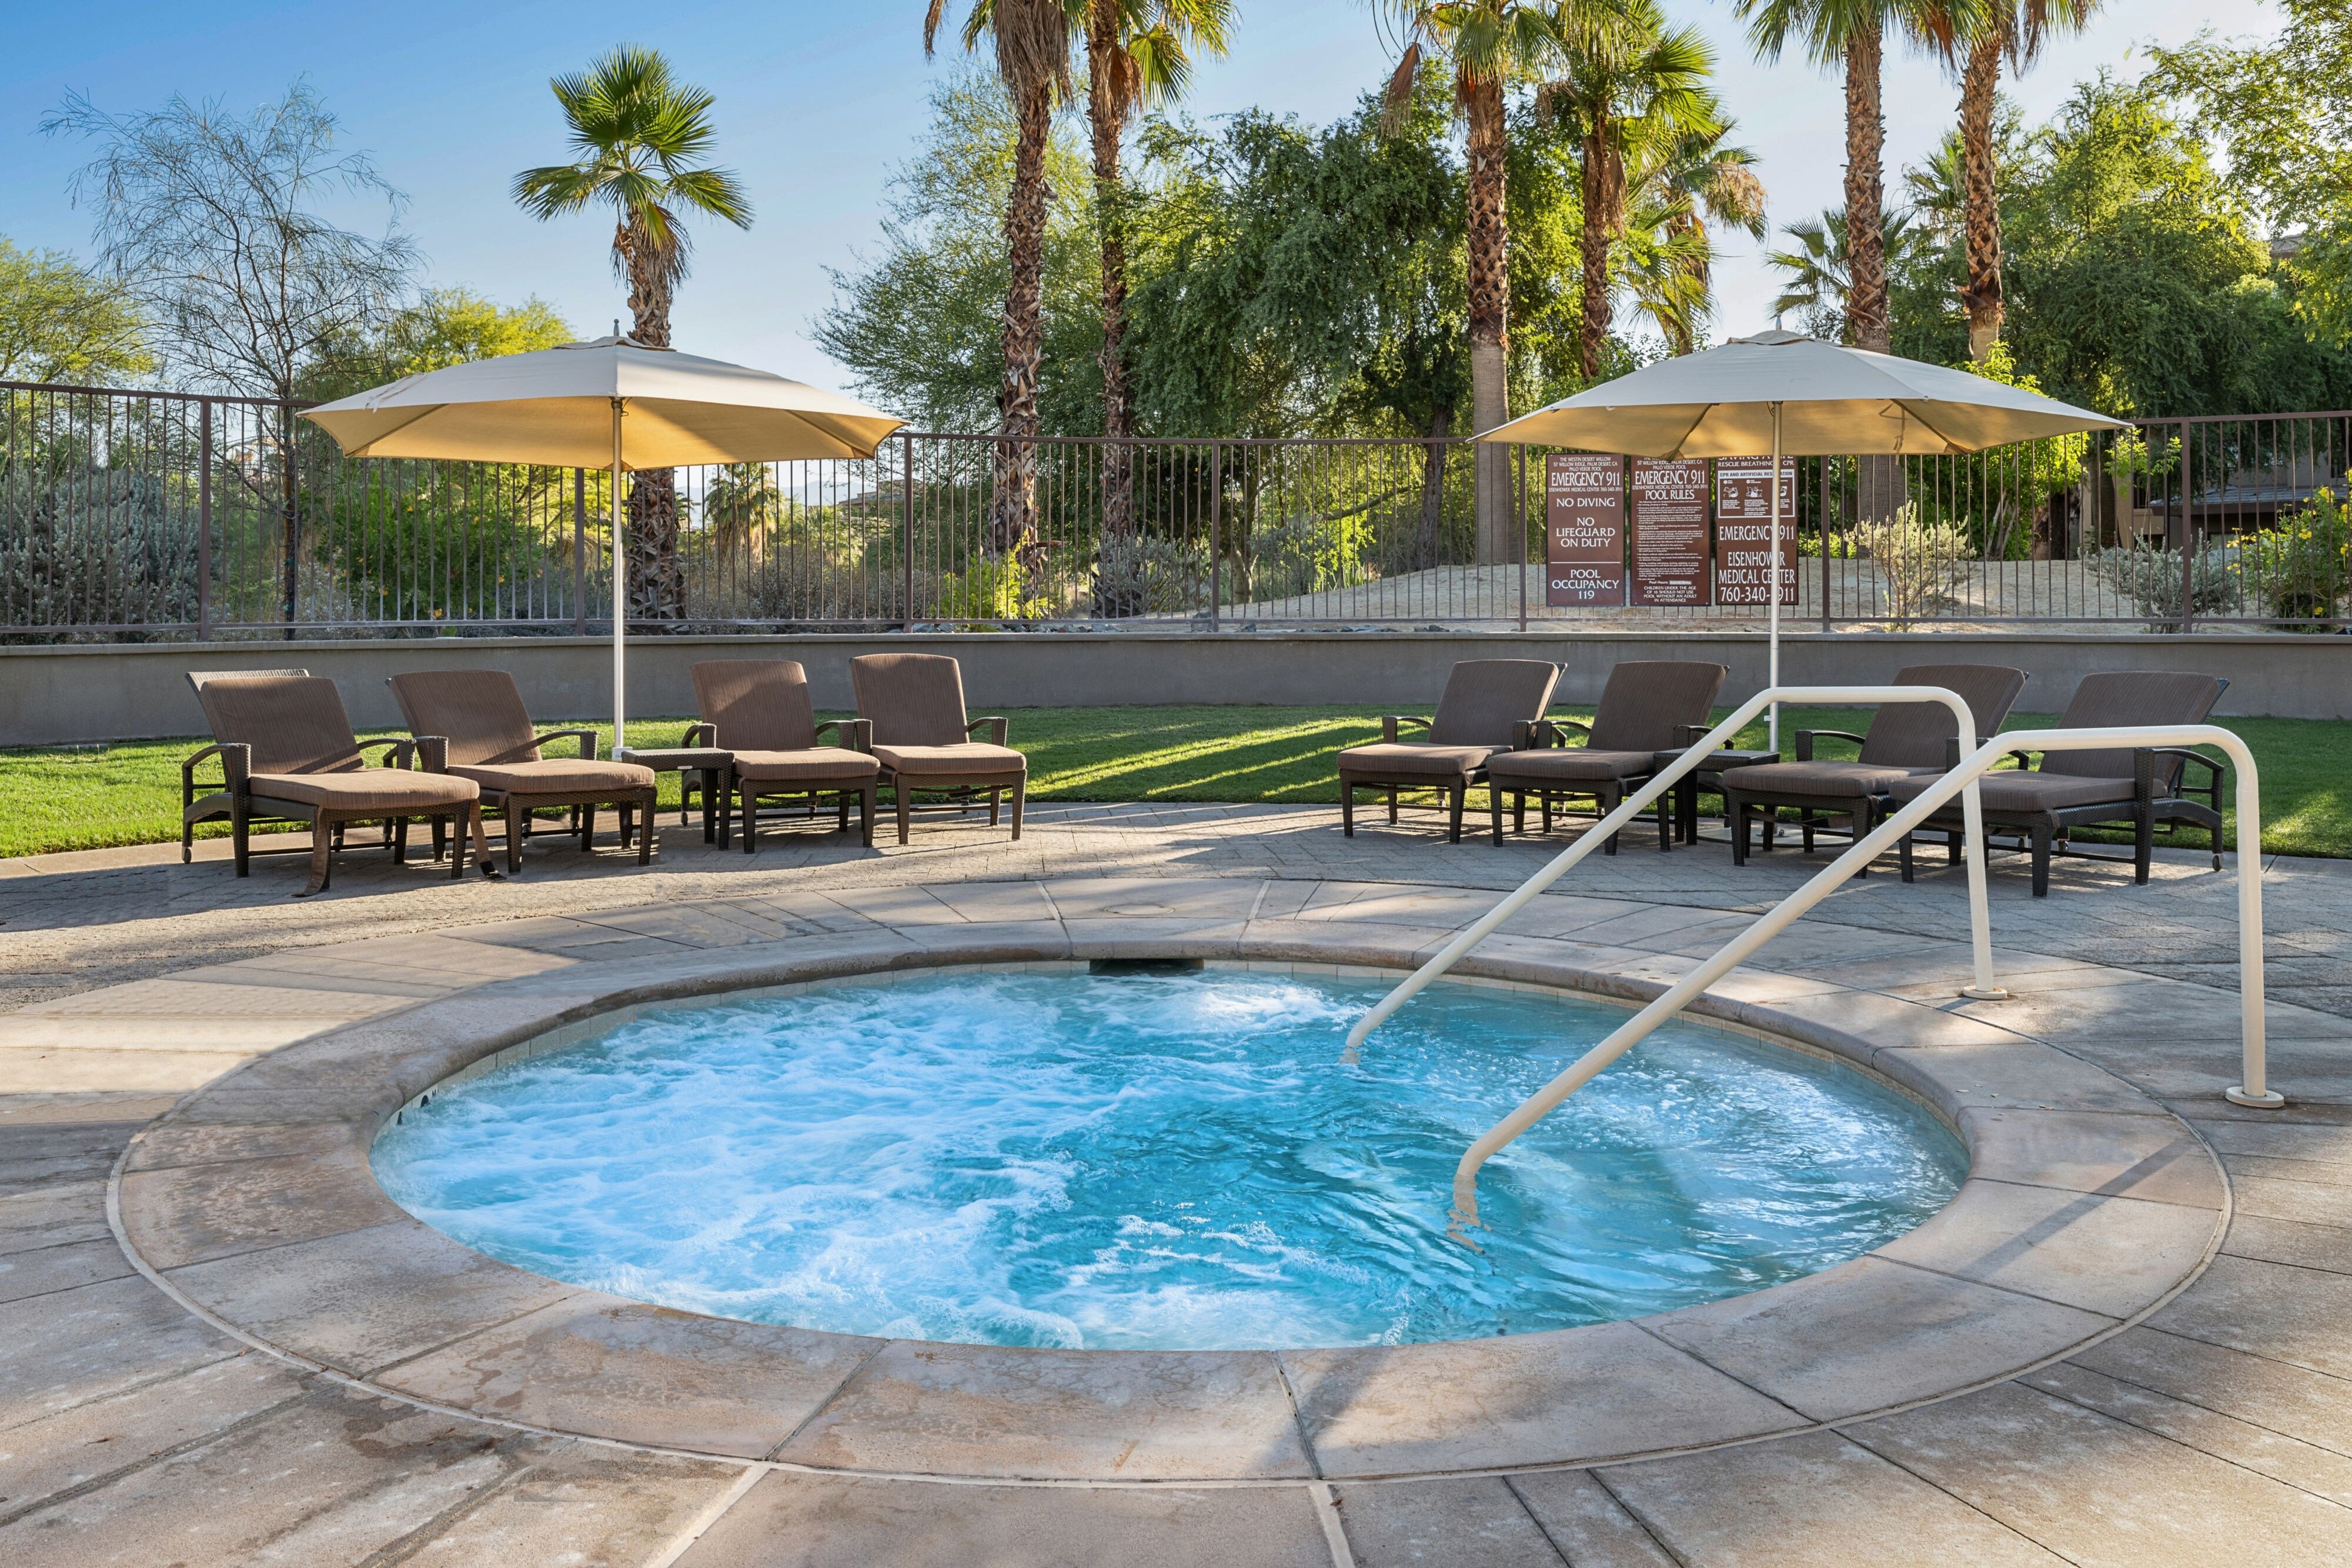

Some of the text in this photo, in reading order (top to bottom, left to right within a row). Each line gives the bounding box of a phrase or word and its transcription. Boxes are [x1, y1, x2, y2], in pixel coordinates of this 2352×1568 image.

[1552, 472, 1619, 486] EMERGENCY 911
[1635, 470, 1705, 485] EMERGENCY 911
[1645, 490, 1695, 500] POOL RULES
[1556, 497, 1615, 507] NO DIVING
[1577, 517, 1595, 526] NO
[1556, 527, 1615, 537] LIFEGUARD
[1779, 525, 1794, 540] 911
[1561, 538, 1611, 547] ON DUTY
[1728, 551, 1786, 566] EISENHOWR
[1571, 569, 1601, 579] POOL
[1719, 569, 1796, 584] MEDICAL CETER
[1552, 580, 1619, 589] OCCUPANCY
[1578, 590, 1595, 599] 119
[1720, 586, 1794, 601] 760-340-911
